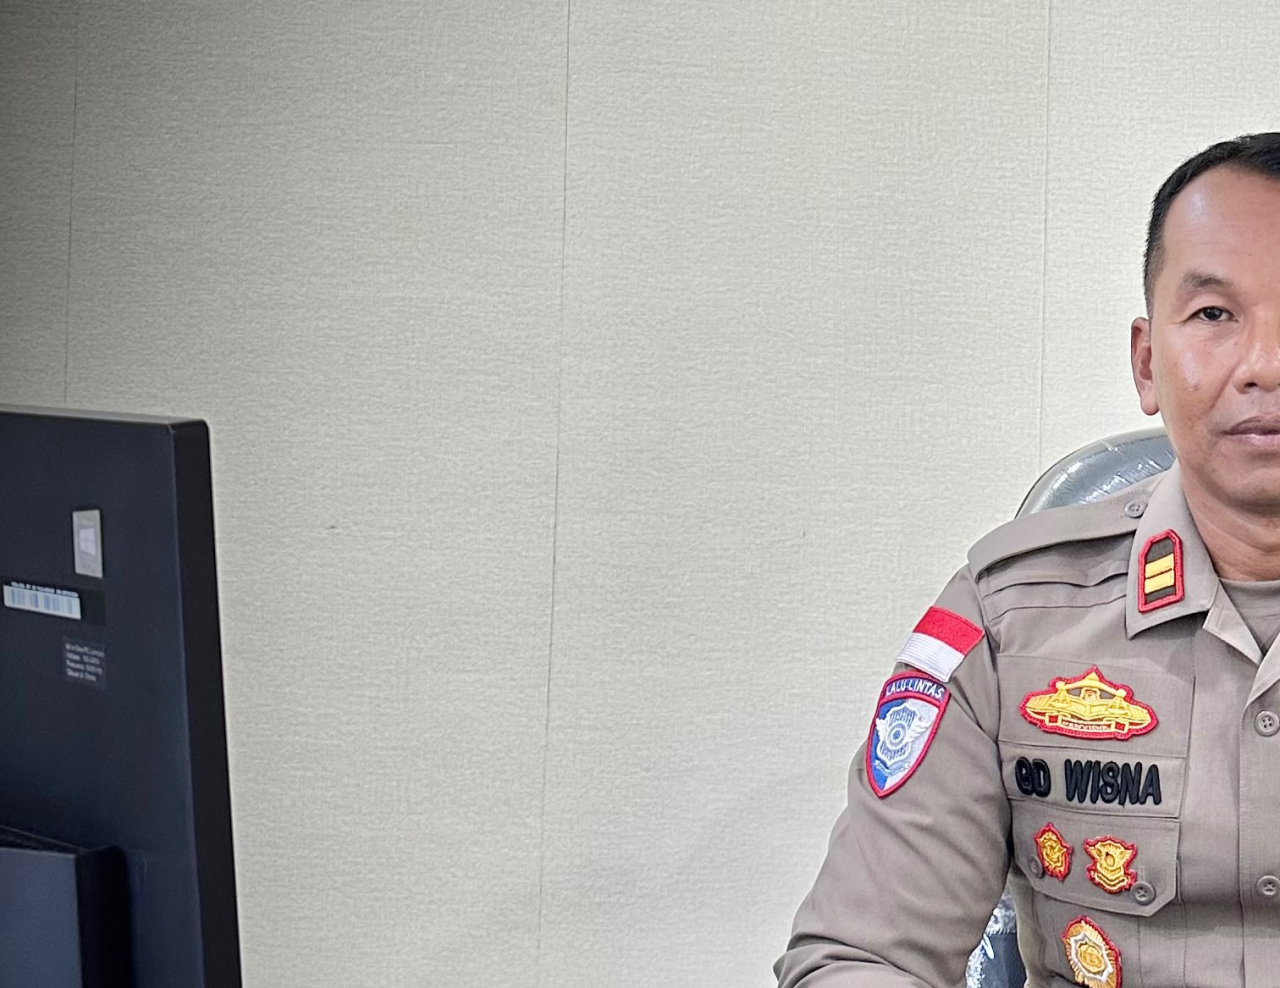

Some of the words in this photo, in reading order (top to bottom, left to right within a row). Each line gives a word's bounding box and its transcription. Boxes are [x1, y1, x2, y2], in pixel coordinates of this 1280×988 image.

[885, 679, 908, 696] LALU
[908, 679, 945, 699] LINTAS
[1065, 758, 1163, 807] WISNA
